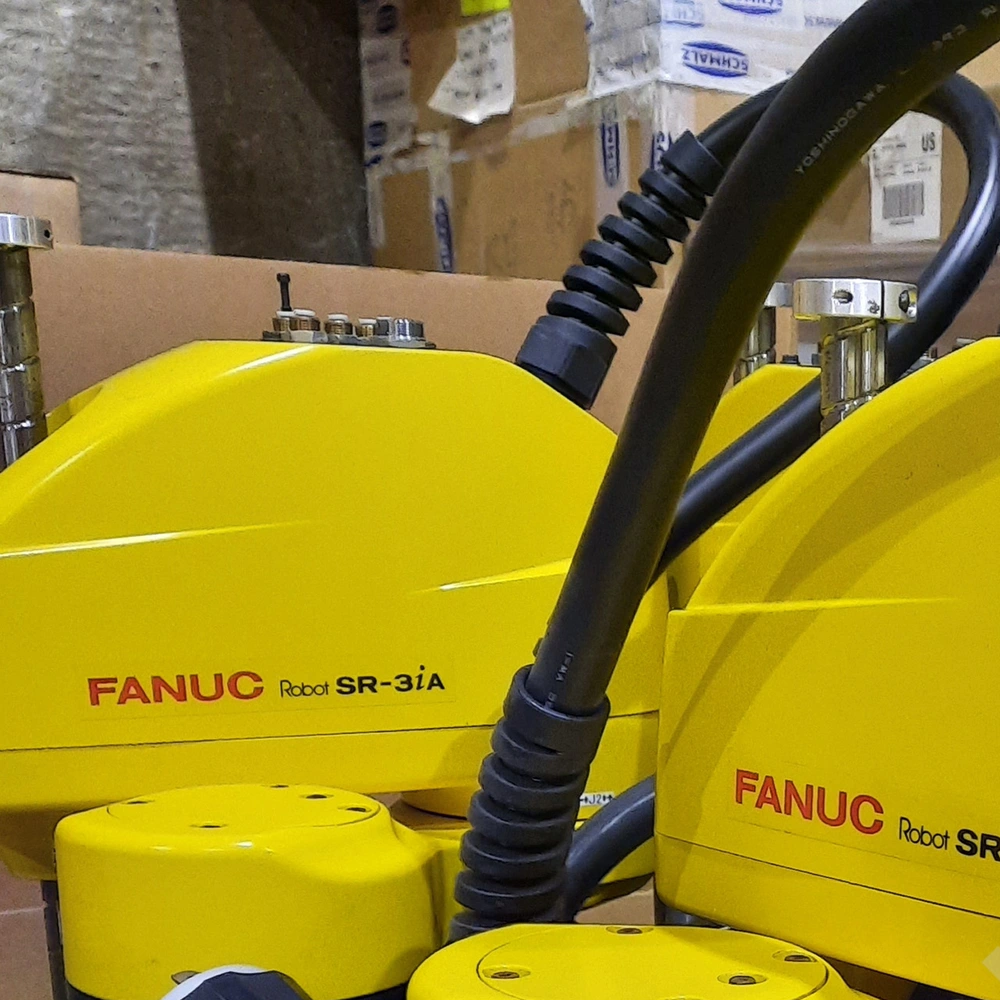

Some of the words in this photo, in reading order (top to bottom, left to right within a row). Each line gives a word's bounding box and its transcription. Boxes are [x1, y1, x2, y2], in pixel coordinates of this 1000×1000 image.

[681, 47, 748, 72] SCHMALZ
[88, 672, 264, 706] FANUC
[280, 680, 329, 698] Robot
[336, 665, 445, 694] SR-3iA
[735, 769, 884, 835] FANUC
[899, 817, 950, 850] Robot
